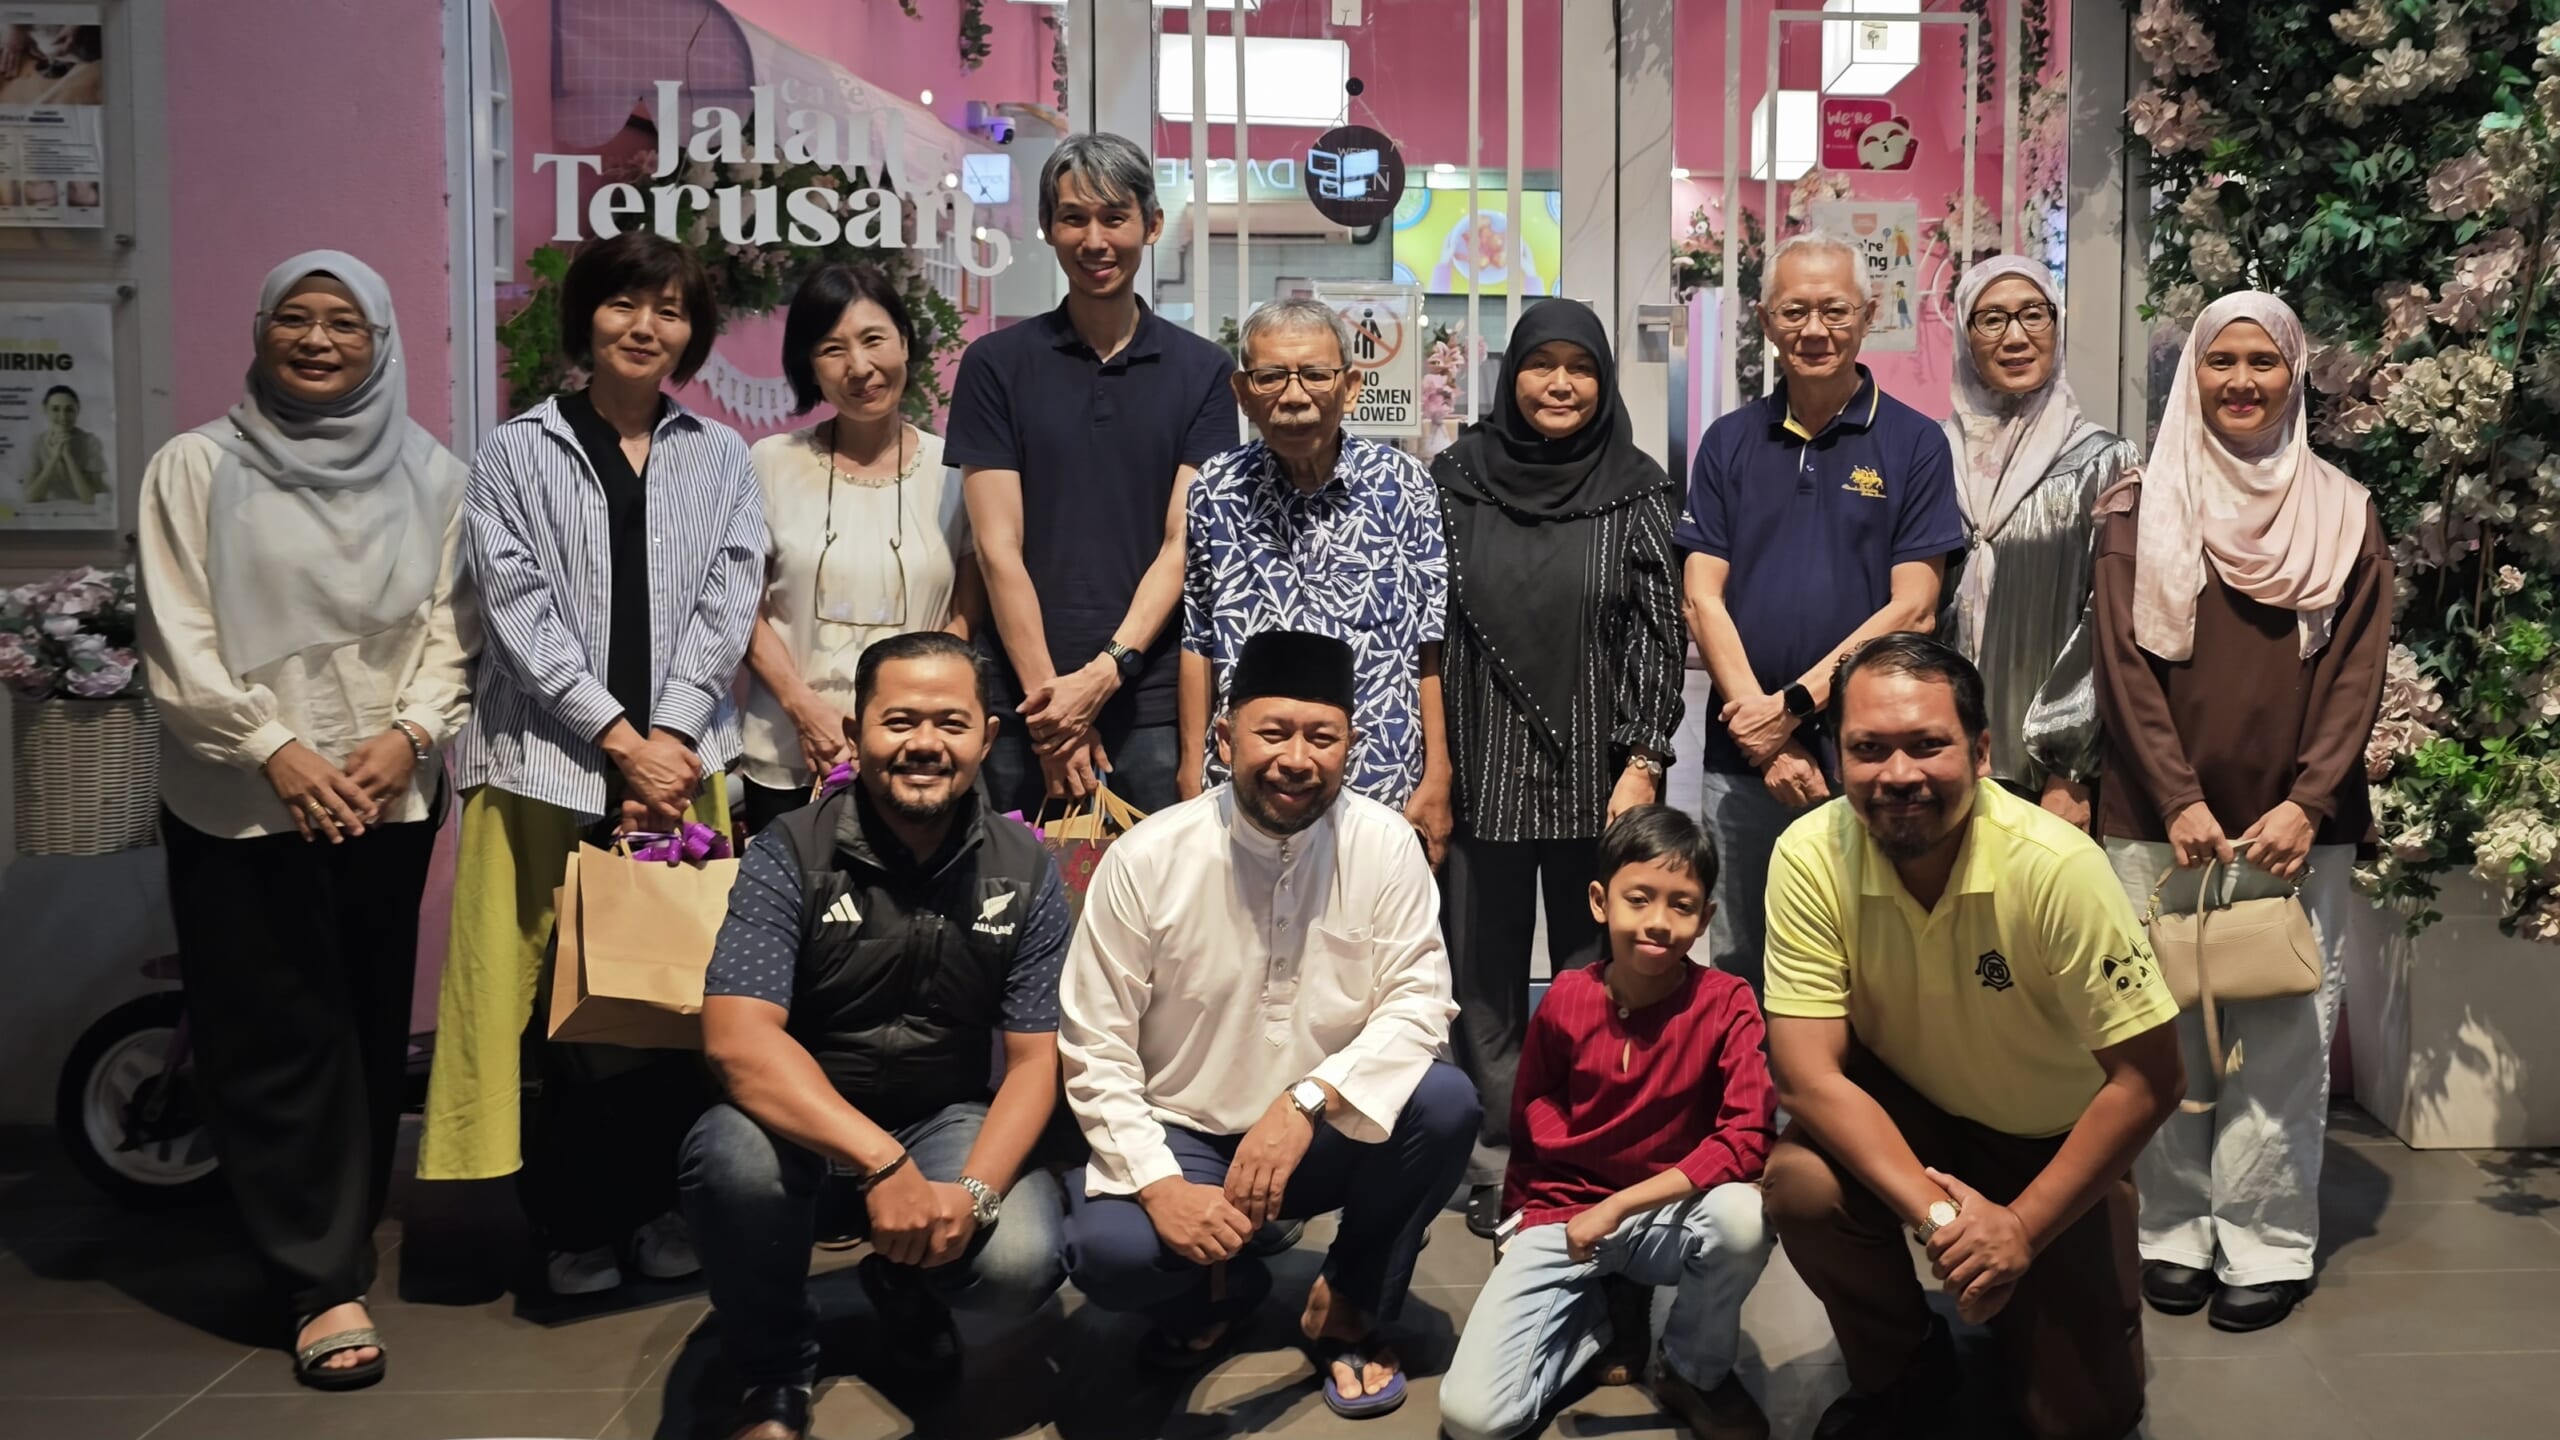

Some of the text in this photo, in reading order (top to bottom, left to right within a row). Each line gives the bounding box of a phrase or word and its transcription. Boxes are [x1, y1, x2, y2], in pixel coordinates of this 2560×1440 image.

[653, 80, 940, 195] Jalan
[533, 153, 1011, 277] Terusan
[0, 353, 73, 371] IRING
[1357, 388, 1411, 404] ESMEN
[1351, 406, 1406, 421] LOWED
